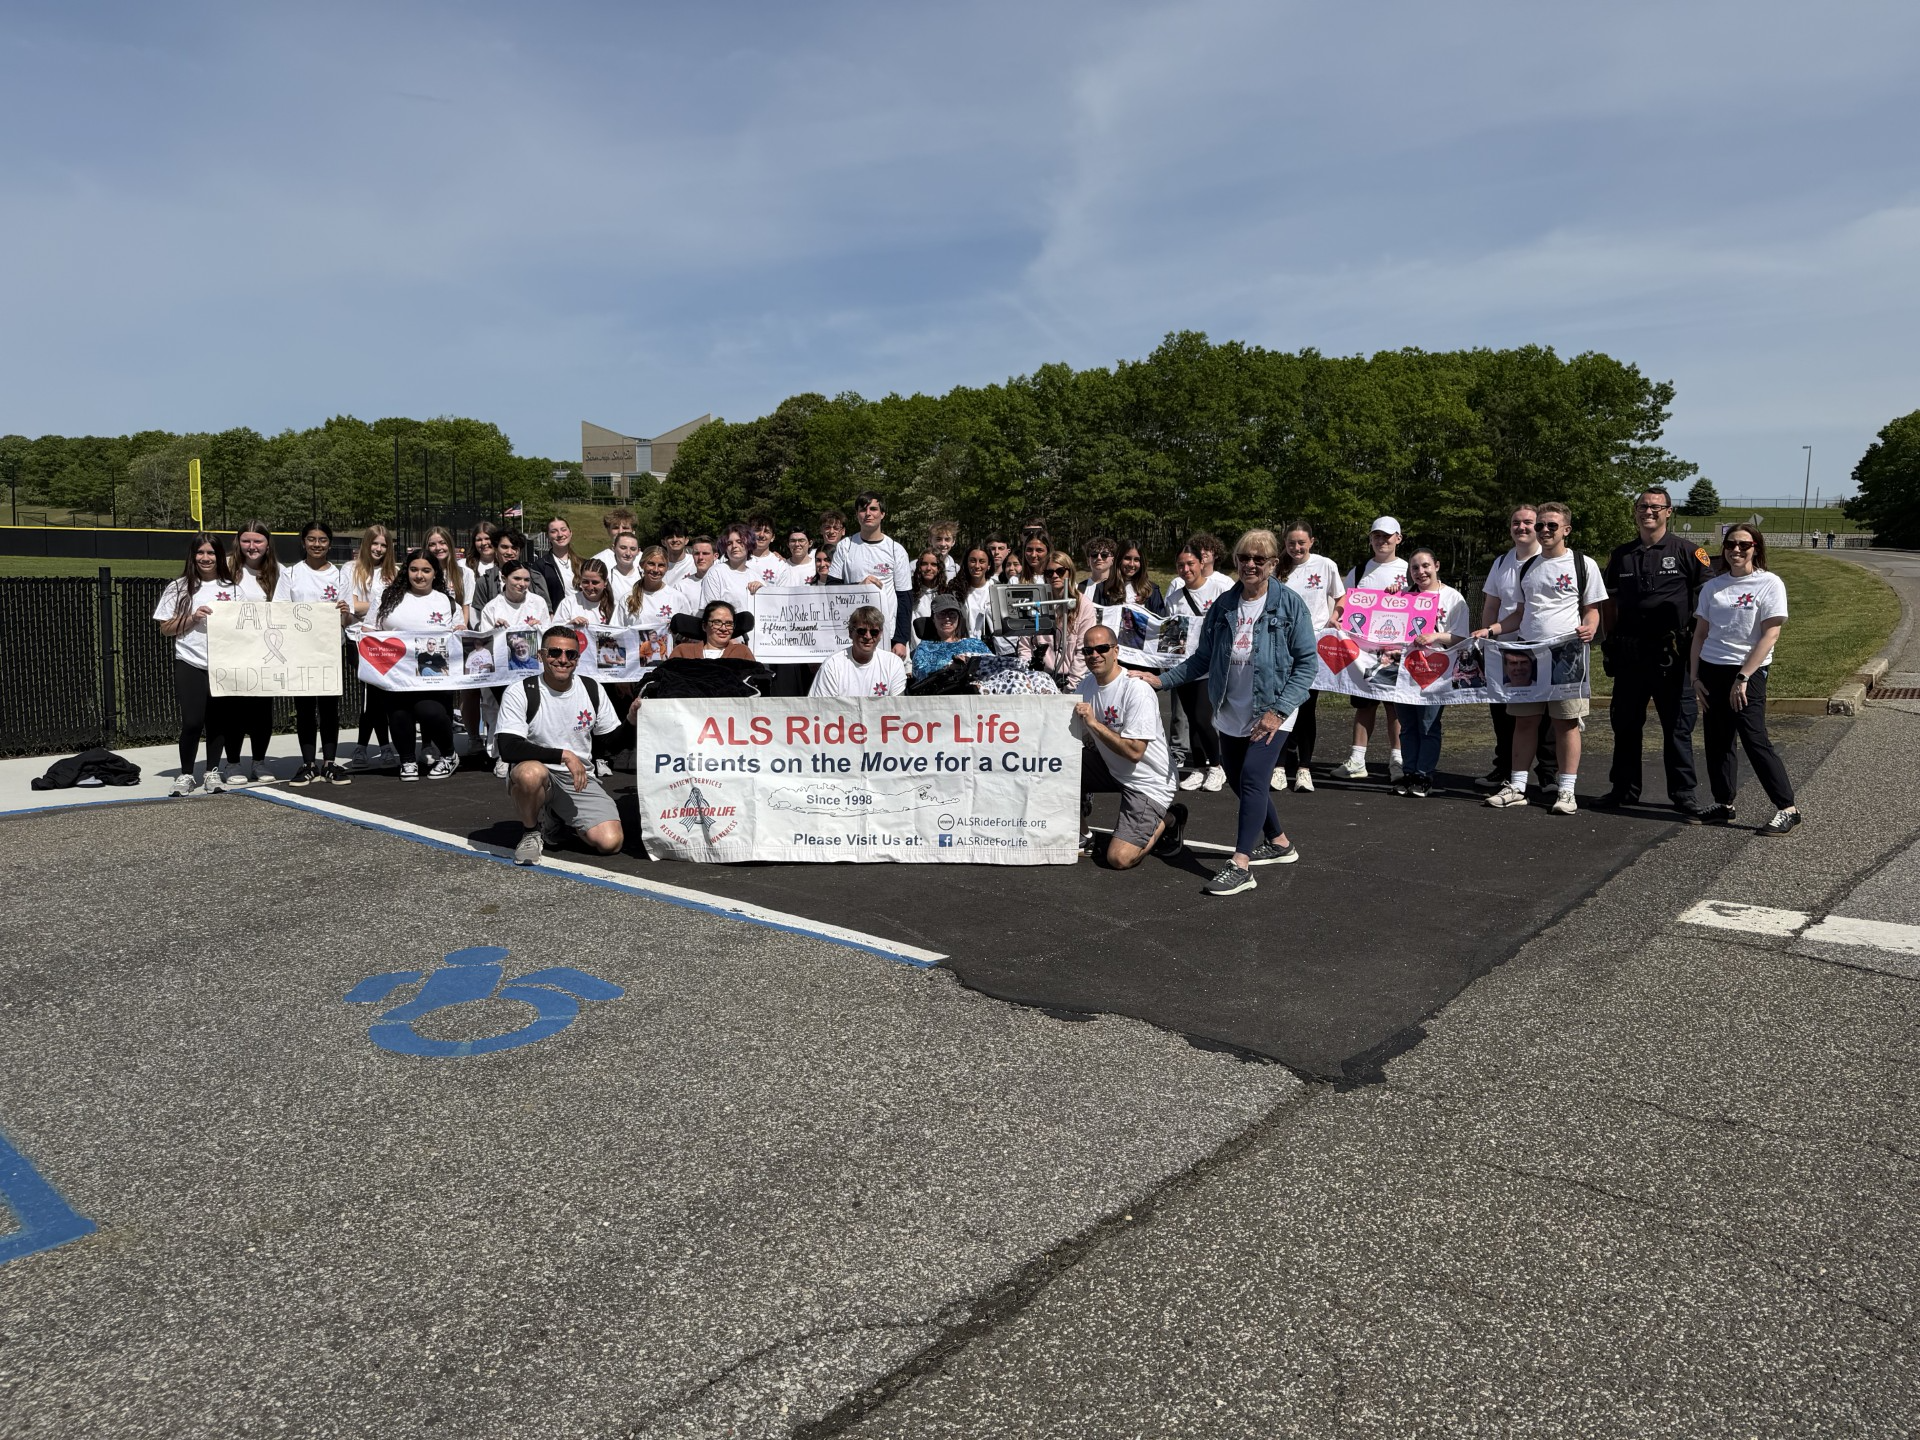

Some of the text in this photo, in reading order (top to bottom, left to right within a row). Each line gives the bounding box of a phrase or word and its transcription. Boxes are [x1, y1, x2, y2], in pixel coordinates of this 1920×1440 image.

[1352, 594, 1432, 609] Say Yes To
[236, 603, 312, 632] ALS
[810, 602, 821, 621] For
[822, 601, 841, 621] Life
[762, 621, 818, 634] fifteen thousand
[697, 713, 1020, 746] ALS Ride For Life
[655, 752, 1062, 774] Patients on the Move for a Cure
[669, 777, 722, 791] PATIENT SERVICES
[806, 794, 873, 805] Since 1998
[660, 806, 679, 820] ALS
[679, 806, 699, 818] RIDE
[716, 806, 737, 817] LIFE
[956, 817, 1047, 829] ALSRideForLife.org
[660, 823, 689, 846] RESEARCH
[793, 833, 923, 846] Please Visit Us at:
[956, 837, 1028, 848] ALSRideForLife
